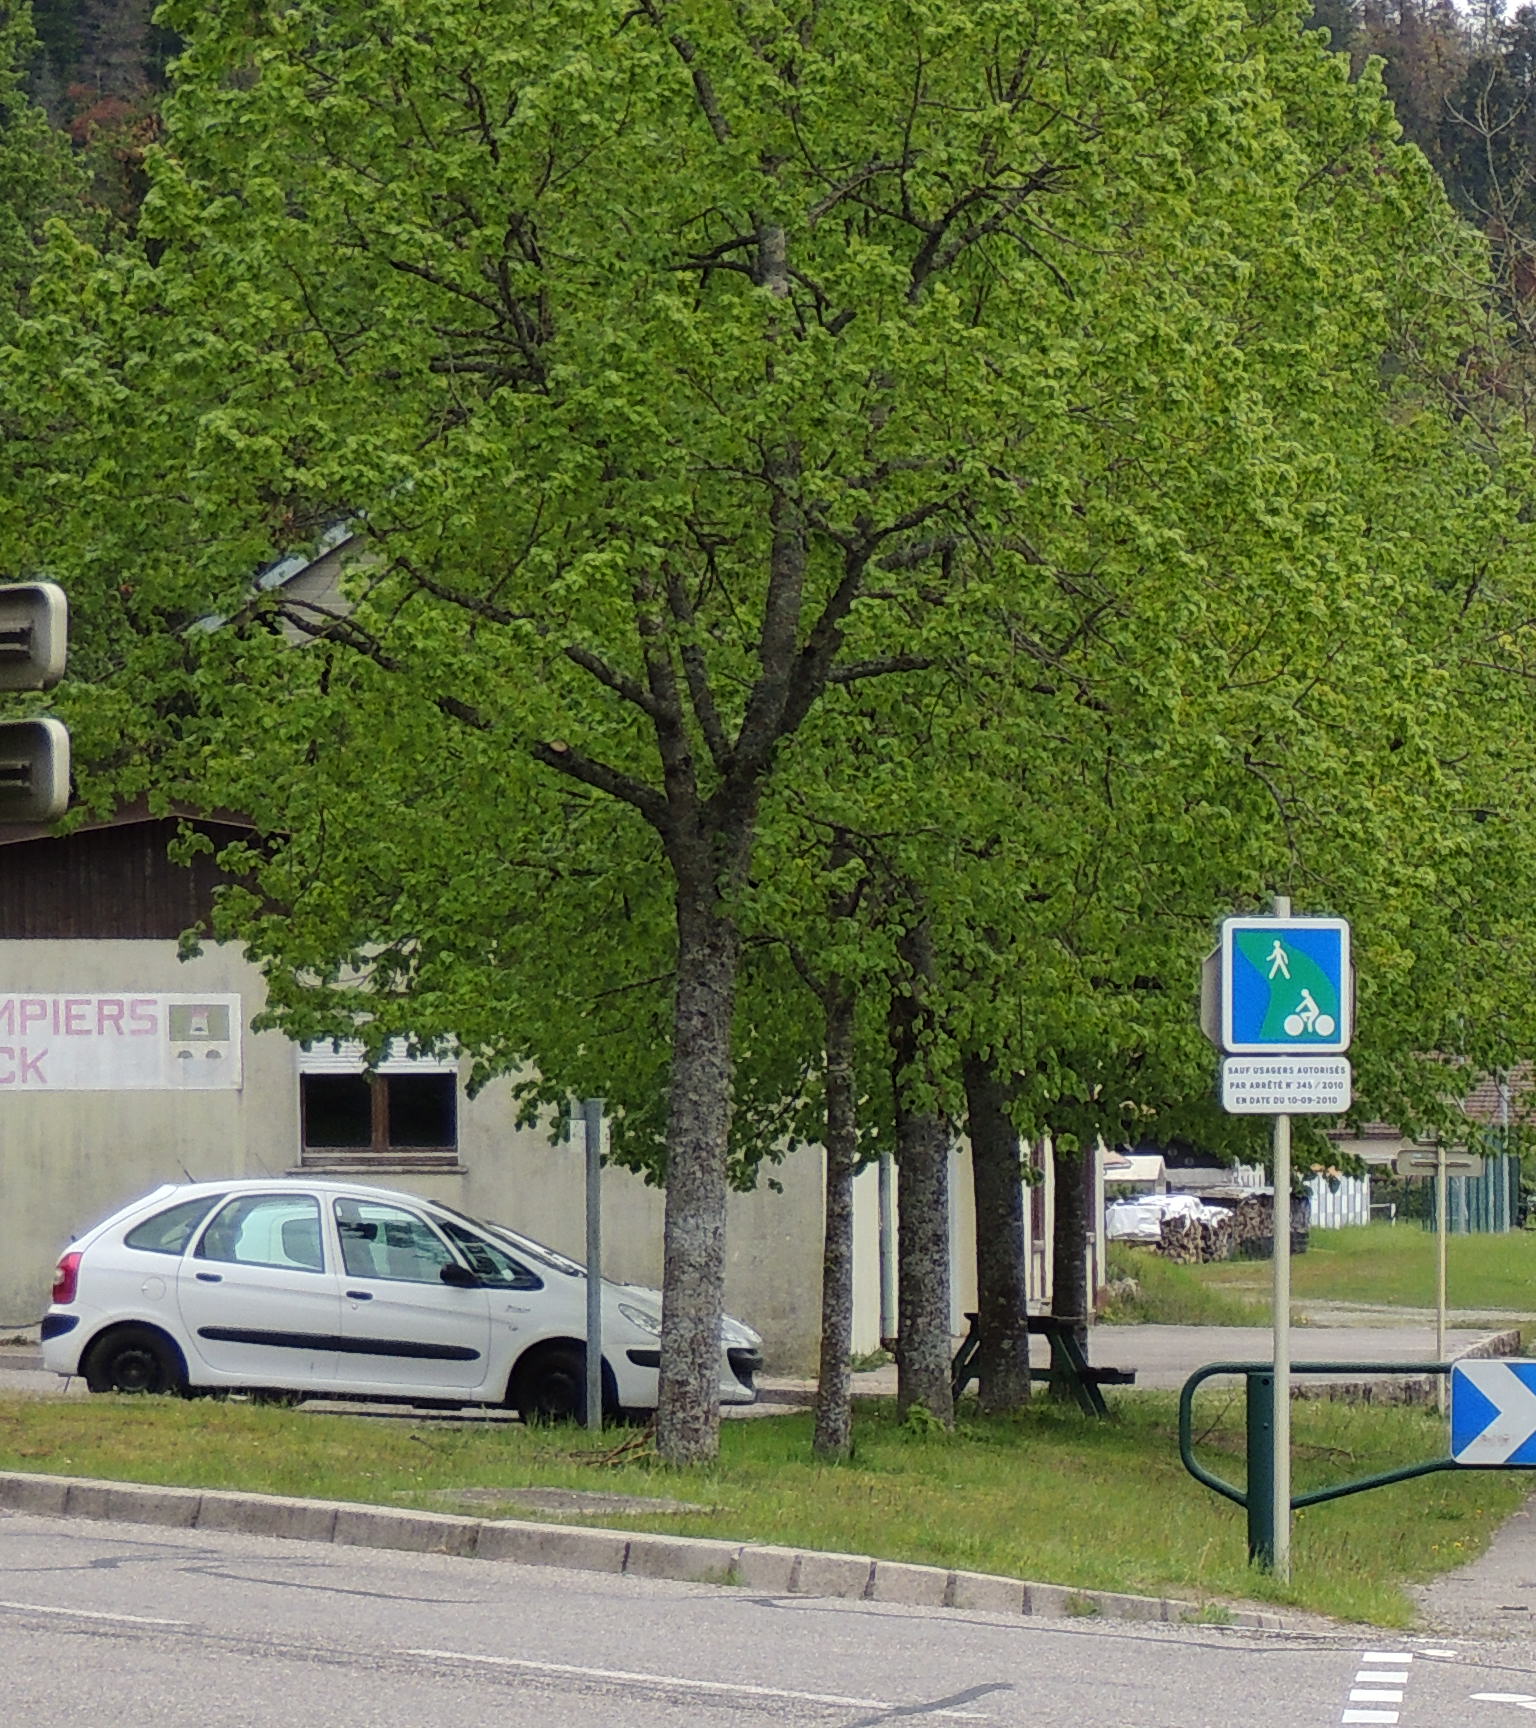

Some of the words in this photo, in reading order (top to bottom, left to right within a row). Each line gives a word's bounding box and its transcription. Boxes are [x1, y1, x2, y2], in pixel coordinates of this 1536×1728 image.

[1227, 1066, 1250, 1074] SAUF
[1252, 1066, 1294, 1075] USAGERS
[1297, 1065, 1346, 1075] AUTORISÉS
[1229, 1081, 1247, 1089] PAR
[1249, 1080, 1283, 1089] ARRÊTÉ
[1235, 1096, 1247, 1105] EN
[1249, 1096, 1271, 1105] DATE
[1273, 1096, 1285, 1105] DU
